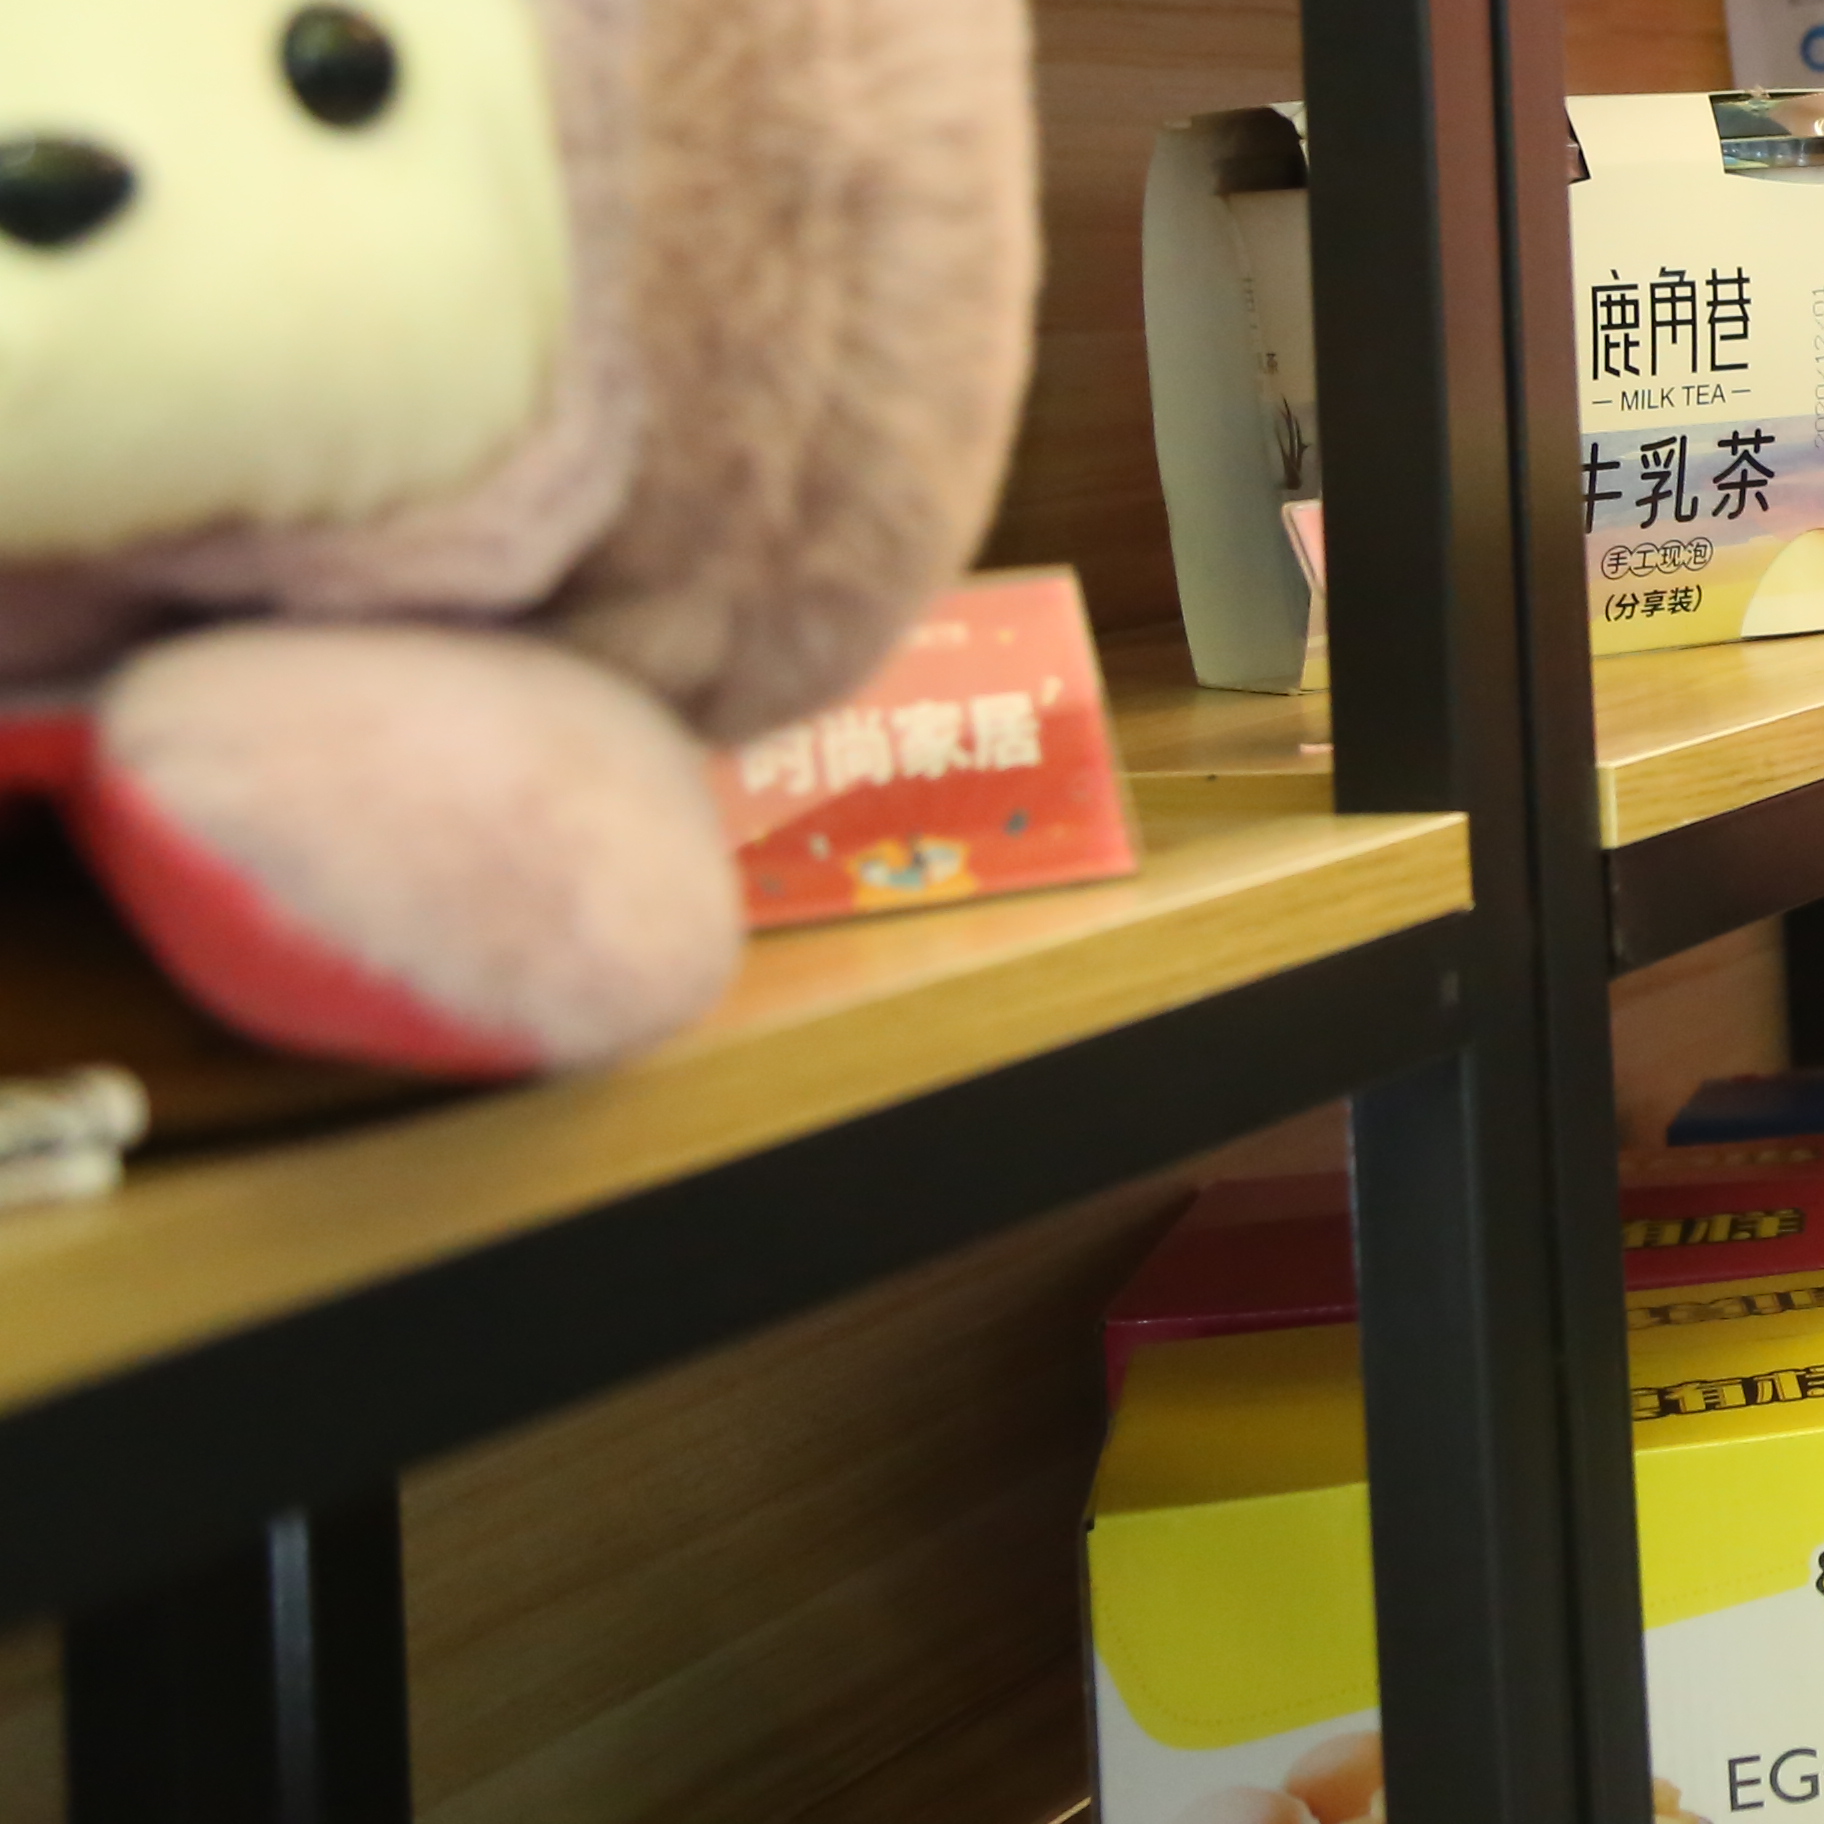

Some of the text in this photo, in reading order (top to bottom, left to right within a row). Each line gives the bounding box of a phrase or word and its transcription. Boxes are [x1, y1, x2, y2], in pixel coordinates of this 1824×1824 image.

[1590, 265, 1751, 381] 鹿角巷
[1620, 383, 1727, 412] MILK TEA
[1604, 540, 1711, 578] 手工现泡
[1605, 584, 1704, 622] (分享装)
